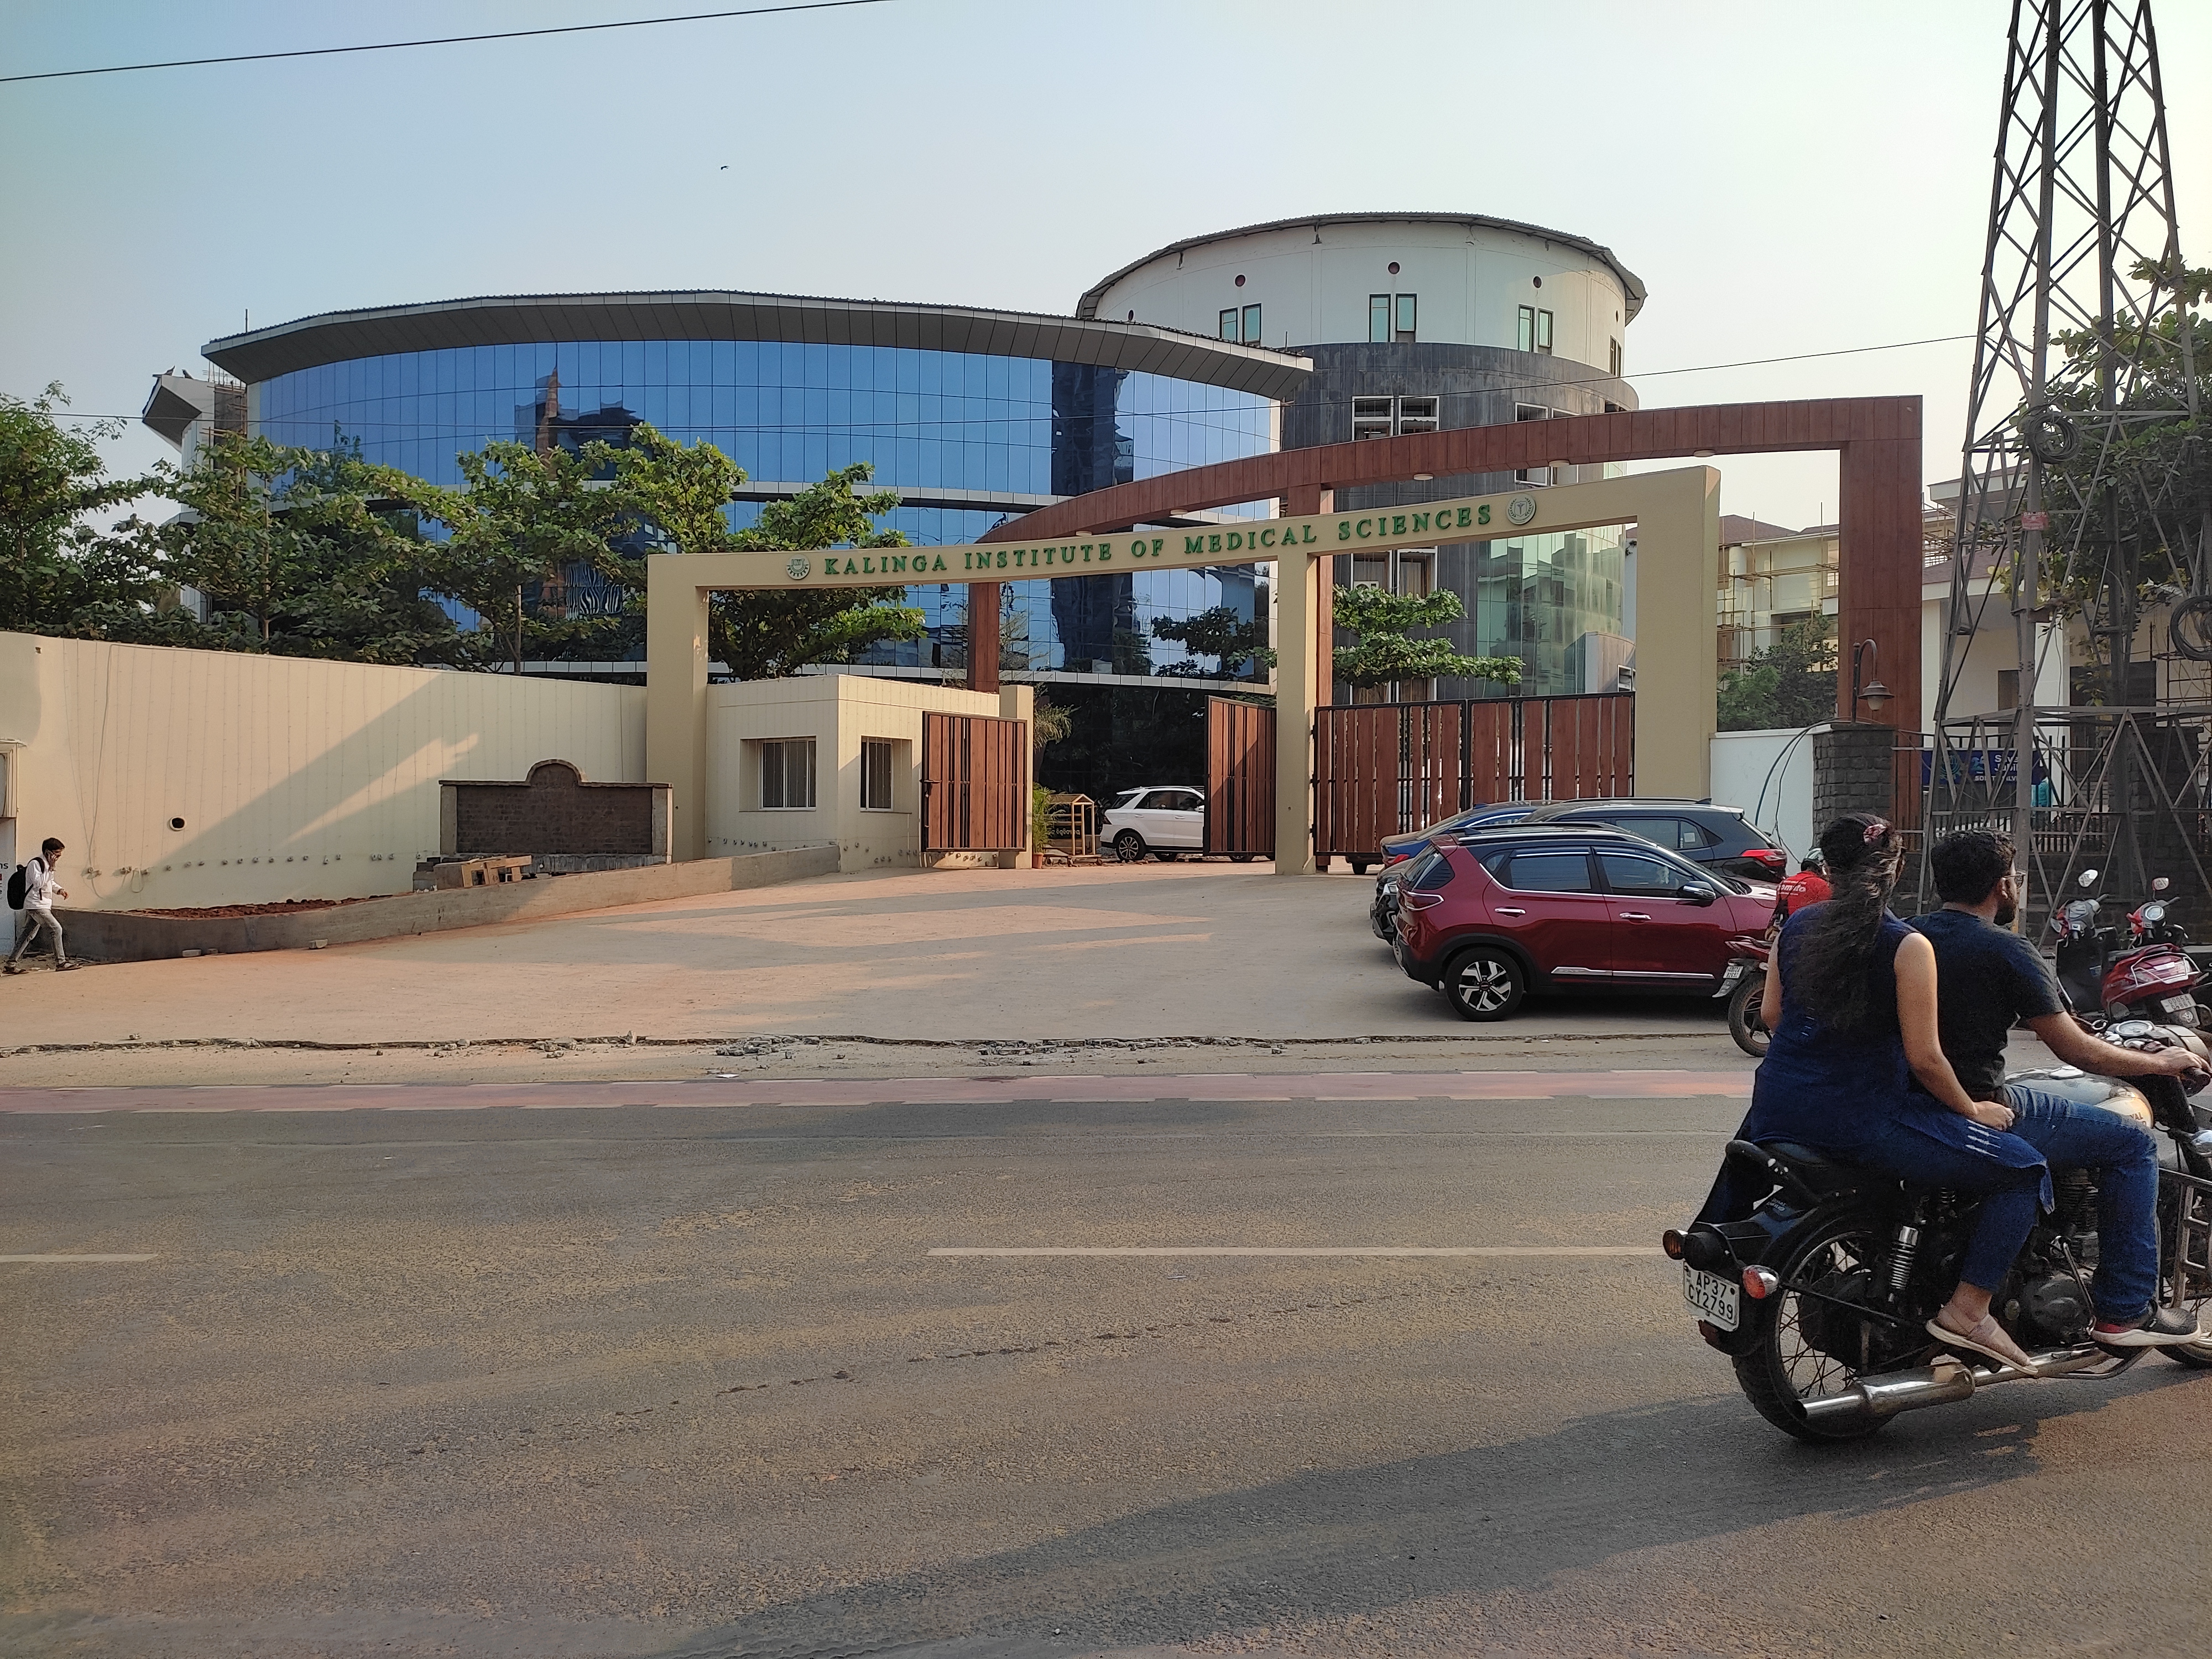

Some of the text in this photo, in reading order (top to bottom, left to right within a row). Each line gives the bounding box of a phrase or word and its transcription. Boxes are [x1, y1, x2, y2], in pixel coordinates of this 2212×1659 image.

[825, 504, 1491, 575] KALINGA INSTITUTE OF MEDICAL SCIENCES
[1689, 1285, 1733, 1319] CY2799
[1696, 1272, 1726, 1298] AP37
